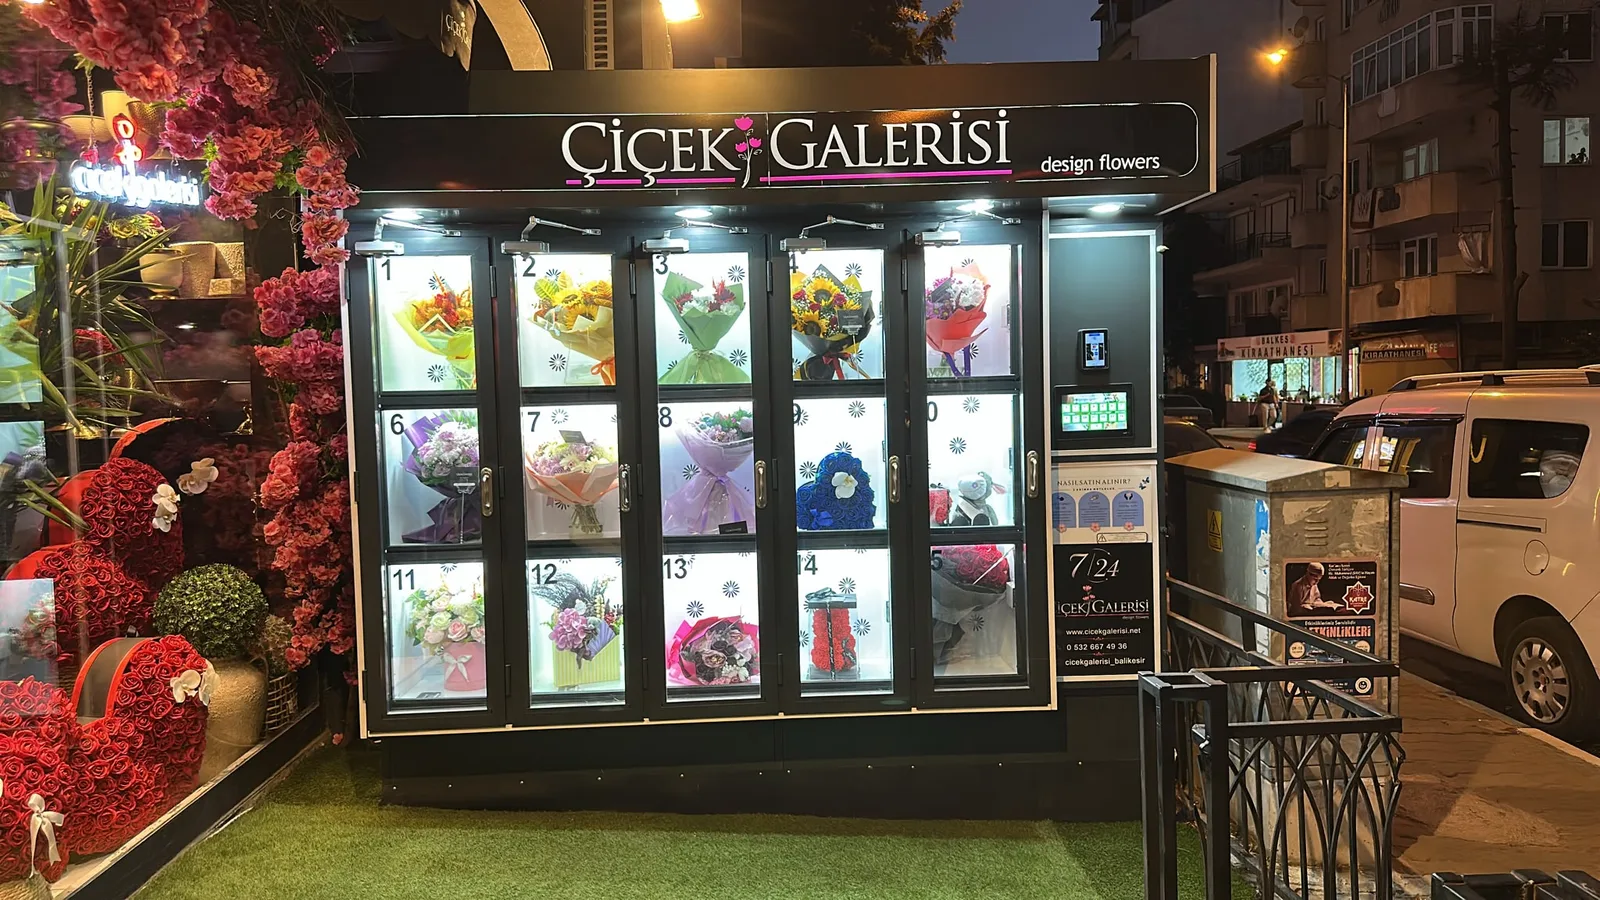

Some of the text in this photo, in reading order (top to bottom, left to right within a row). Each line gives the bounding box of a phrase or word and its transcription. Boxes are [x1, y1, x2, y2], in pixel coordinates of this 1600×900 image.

[561, 109, 1012, 188] ÇİÇEK GALERİSİ
[1040, 153, 1161, 176] design flowers
[381, 259, 391, 280] 1
[522, 256, 536, 277] 2
[655, 254, 669, 275] 3
[1261, 335, 1289, 345] BALKES
[527, 411, 541, 432] 7
[659, 406, 673, 428] 8
[926, 401, 938, 422] 0
[390, 414, 405, 435] 6
[663, 558, 687, 580] 13
[931, 550, 943, 571] 5
[1069, 552, 1120, 579] 7/24
[393, 569, 415, 590] 11
[531, 563, 557, 585] 12
[1057, 599, 1149, 617] İÇEK GALERİSİ
[1066, 627, 1141, 636] www.cicekgalerisi.net
[1073, 643, 1088, 651] 532
[1117, 642, 1128, 650] 36
[1065, 656, 1146, 667] cicekgalerisi_balikesir
